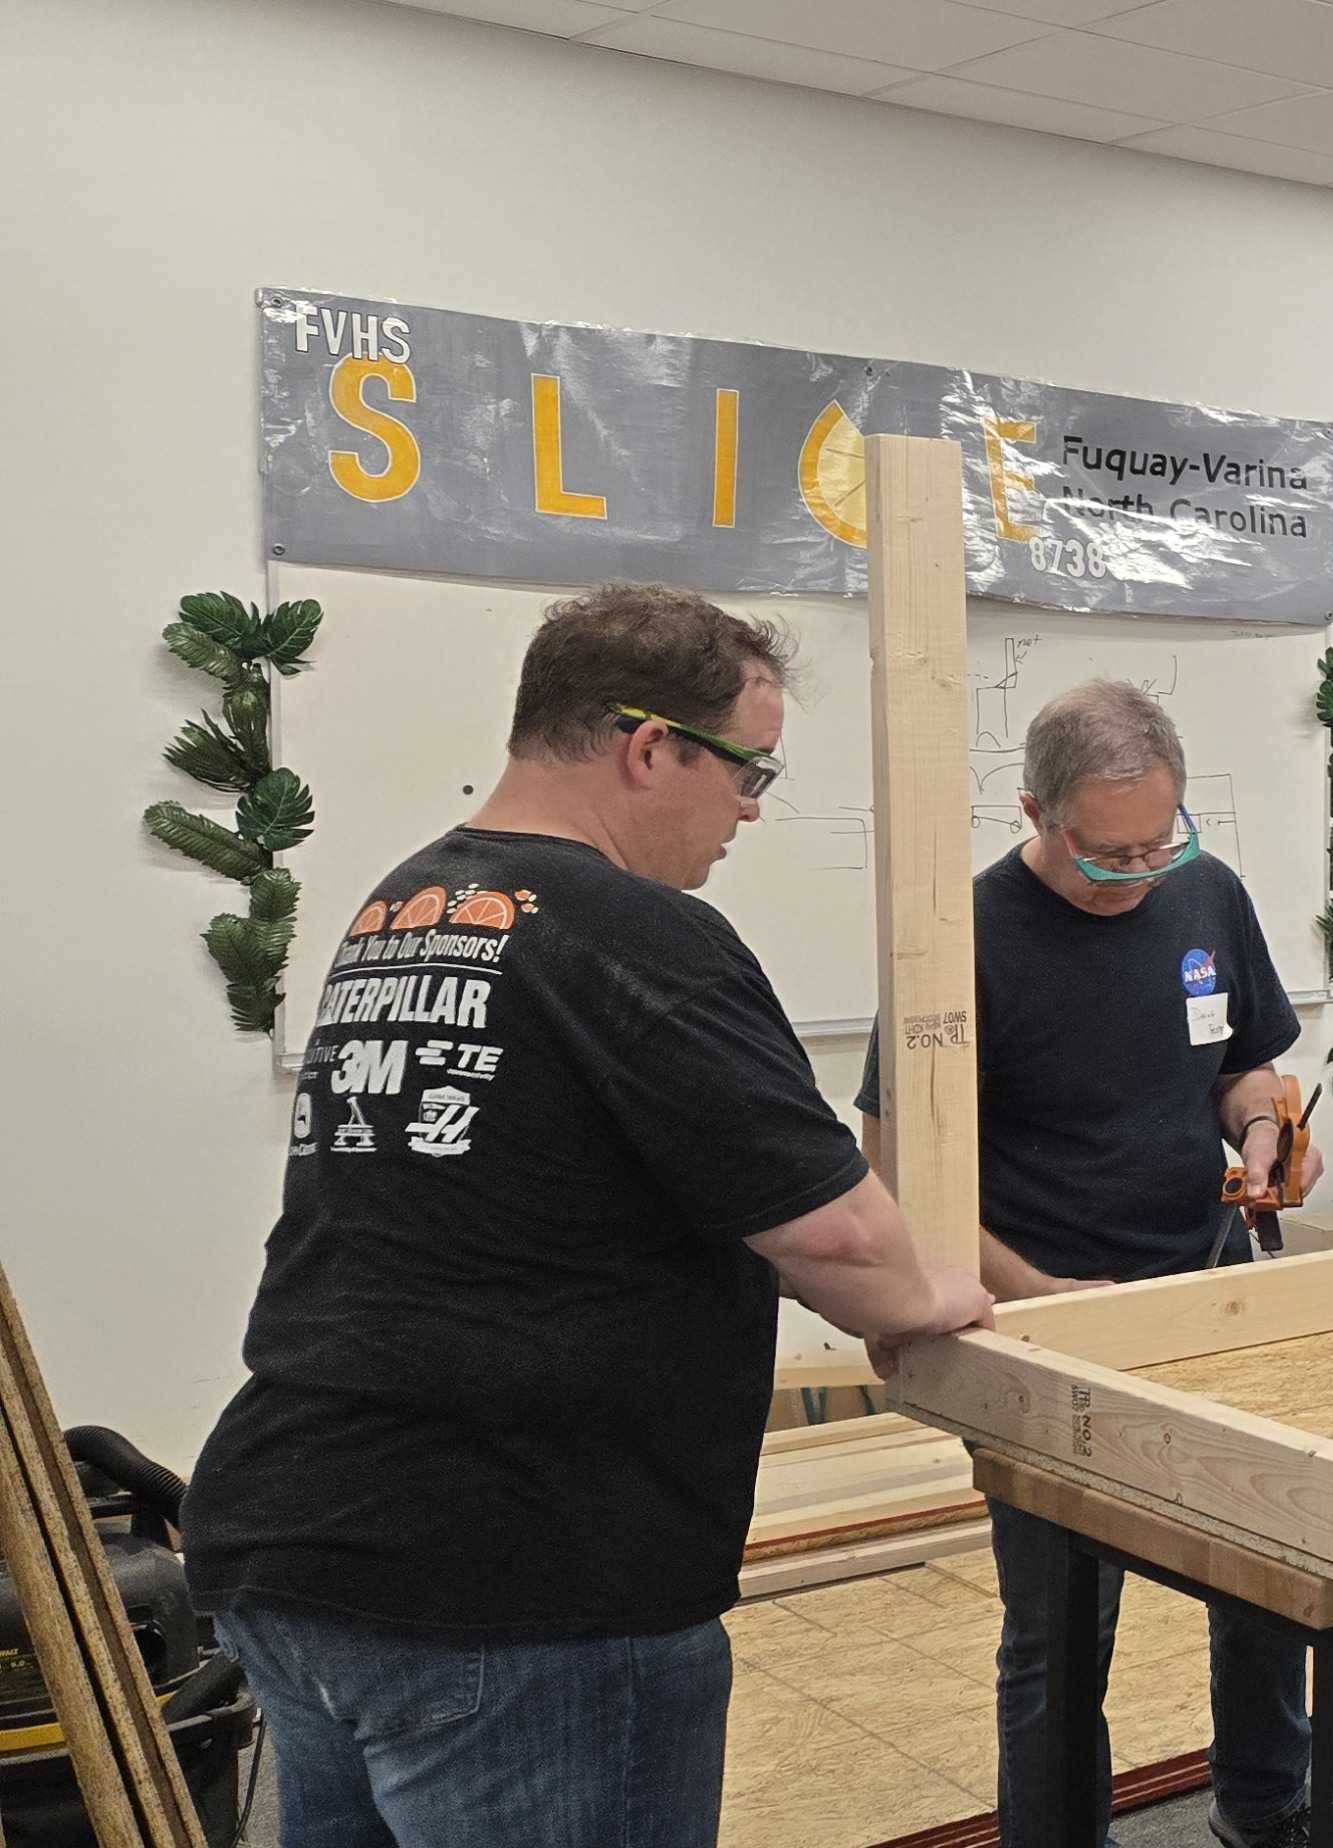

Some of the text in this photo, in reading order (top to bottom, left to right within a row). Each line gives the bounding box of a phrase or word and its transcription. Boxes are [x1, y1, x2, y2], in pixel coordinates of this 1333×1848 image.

[293, 301, 412, 364] FVHS
[1062, 435, 1308, 491] Fuquay-Varina
[1062, 485, 1307, 538] North Carolina
[1028, 536, 1107, 578] 8738
[419, 929, 510, 963] Sponsors!
[1184, 965, 1217, 982] NASA
[318, 975, 491, 1029] CATERPILLAR
[331, 1039, 408, 1095] 3M
[457, 1043, 504, 1072] TE
[906, 1033, 943, 1050] NO.2
